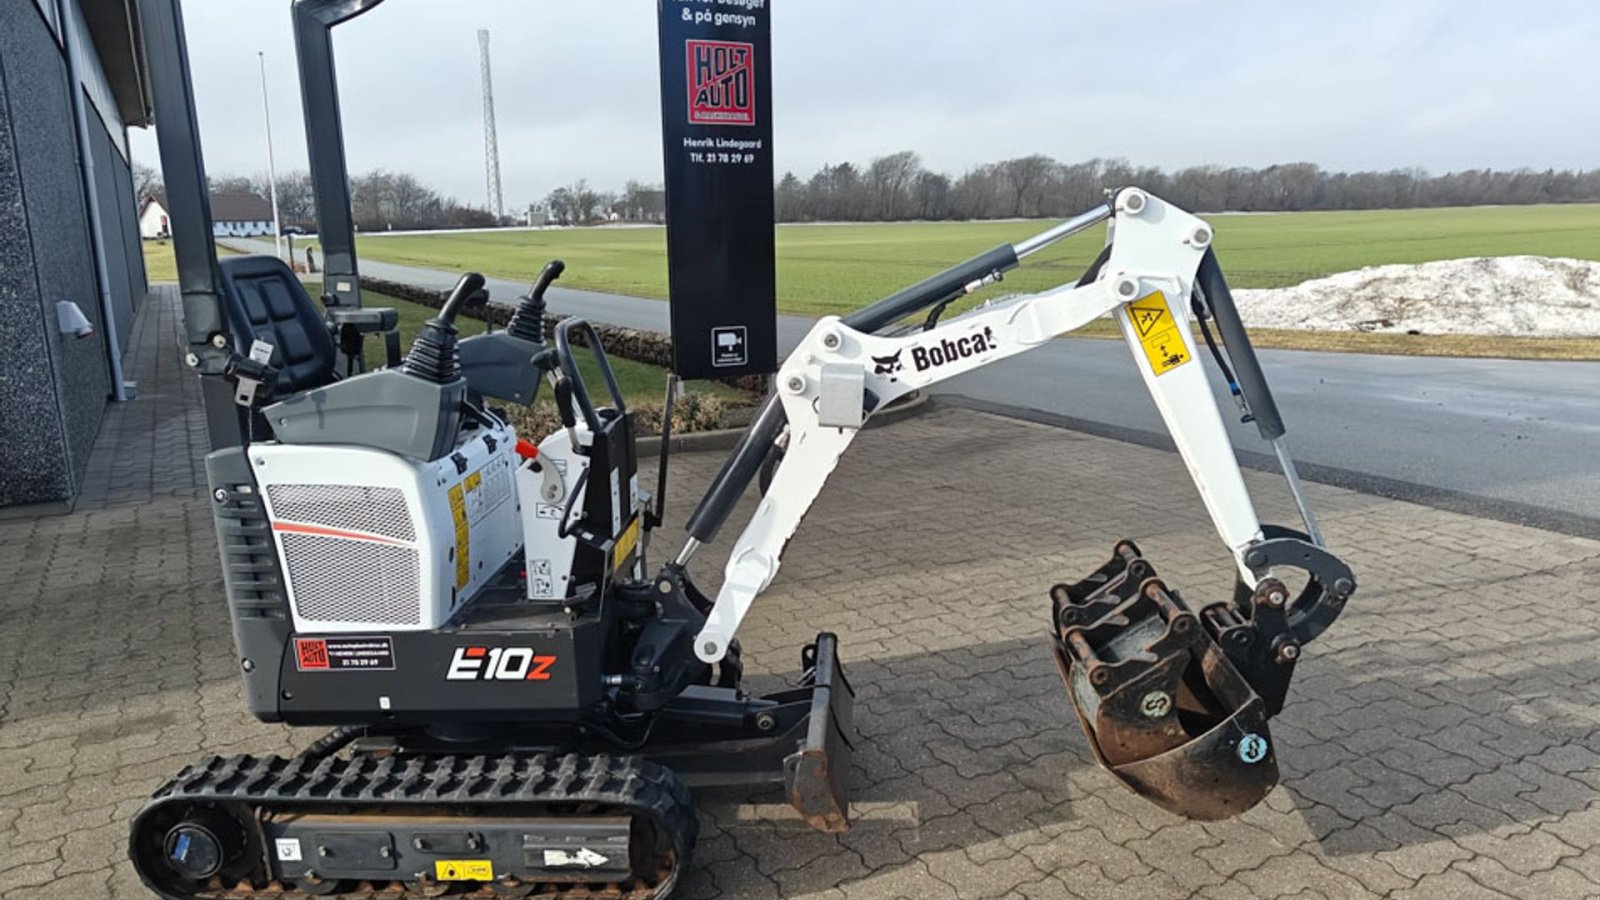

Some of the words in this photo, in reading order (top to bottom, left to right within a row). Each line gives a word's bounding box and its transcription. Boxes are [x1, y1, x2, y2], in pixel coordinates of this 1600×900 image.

[681, 7, 693, 21] &
[695, 8, 712, 25] på
[714, 13, 756, 28] gensyn
[695, 45, 748, 88] HOLT
[694, 66, 748, 109] AUTO
[683, 137, 714, 148] Henrik
[716, 137, 762, 151] Lindegaard
[707, 153, 716, 163] 21
[718, 153, 729, 163] 78
[731, 153, 742, 164] 29
[911, 326, 997, 372] Bobcat
